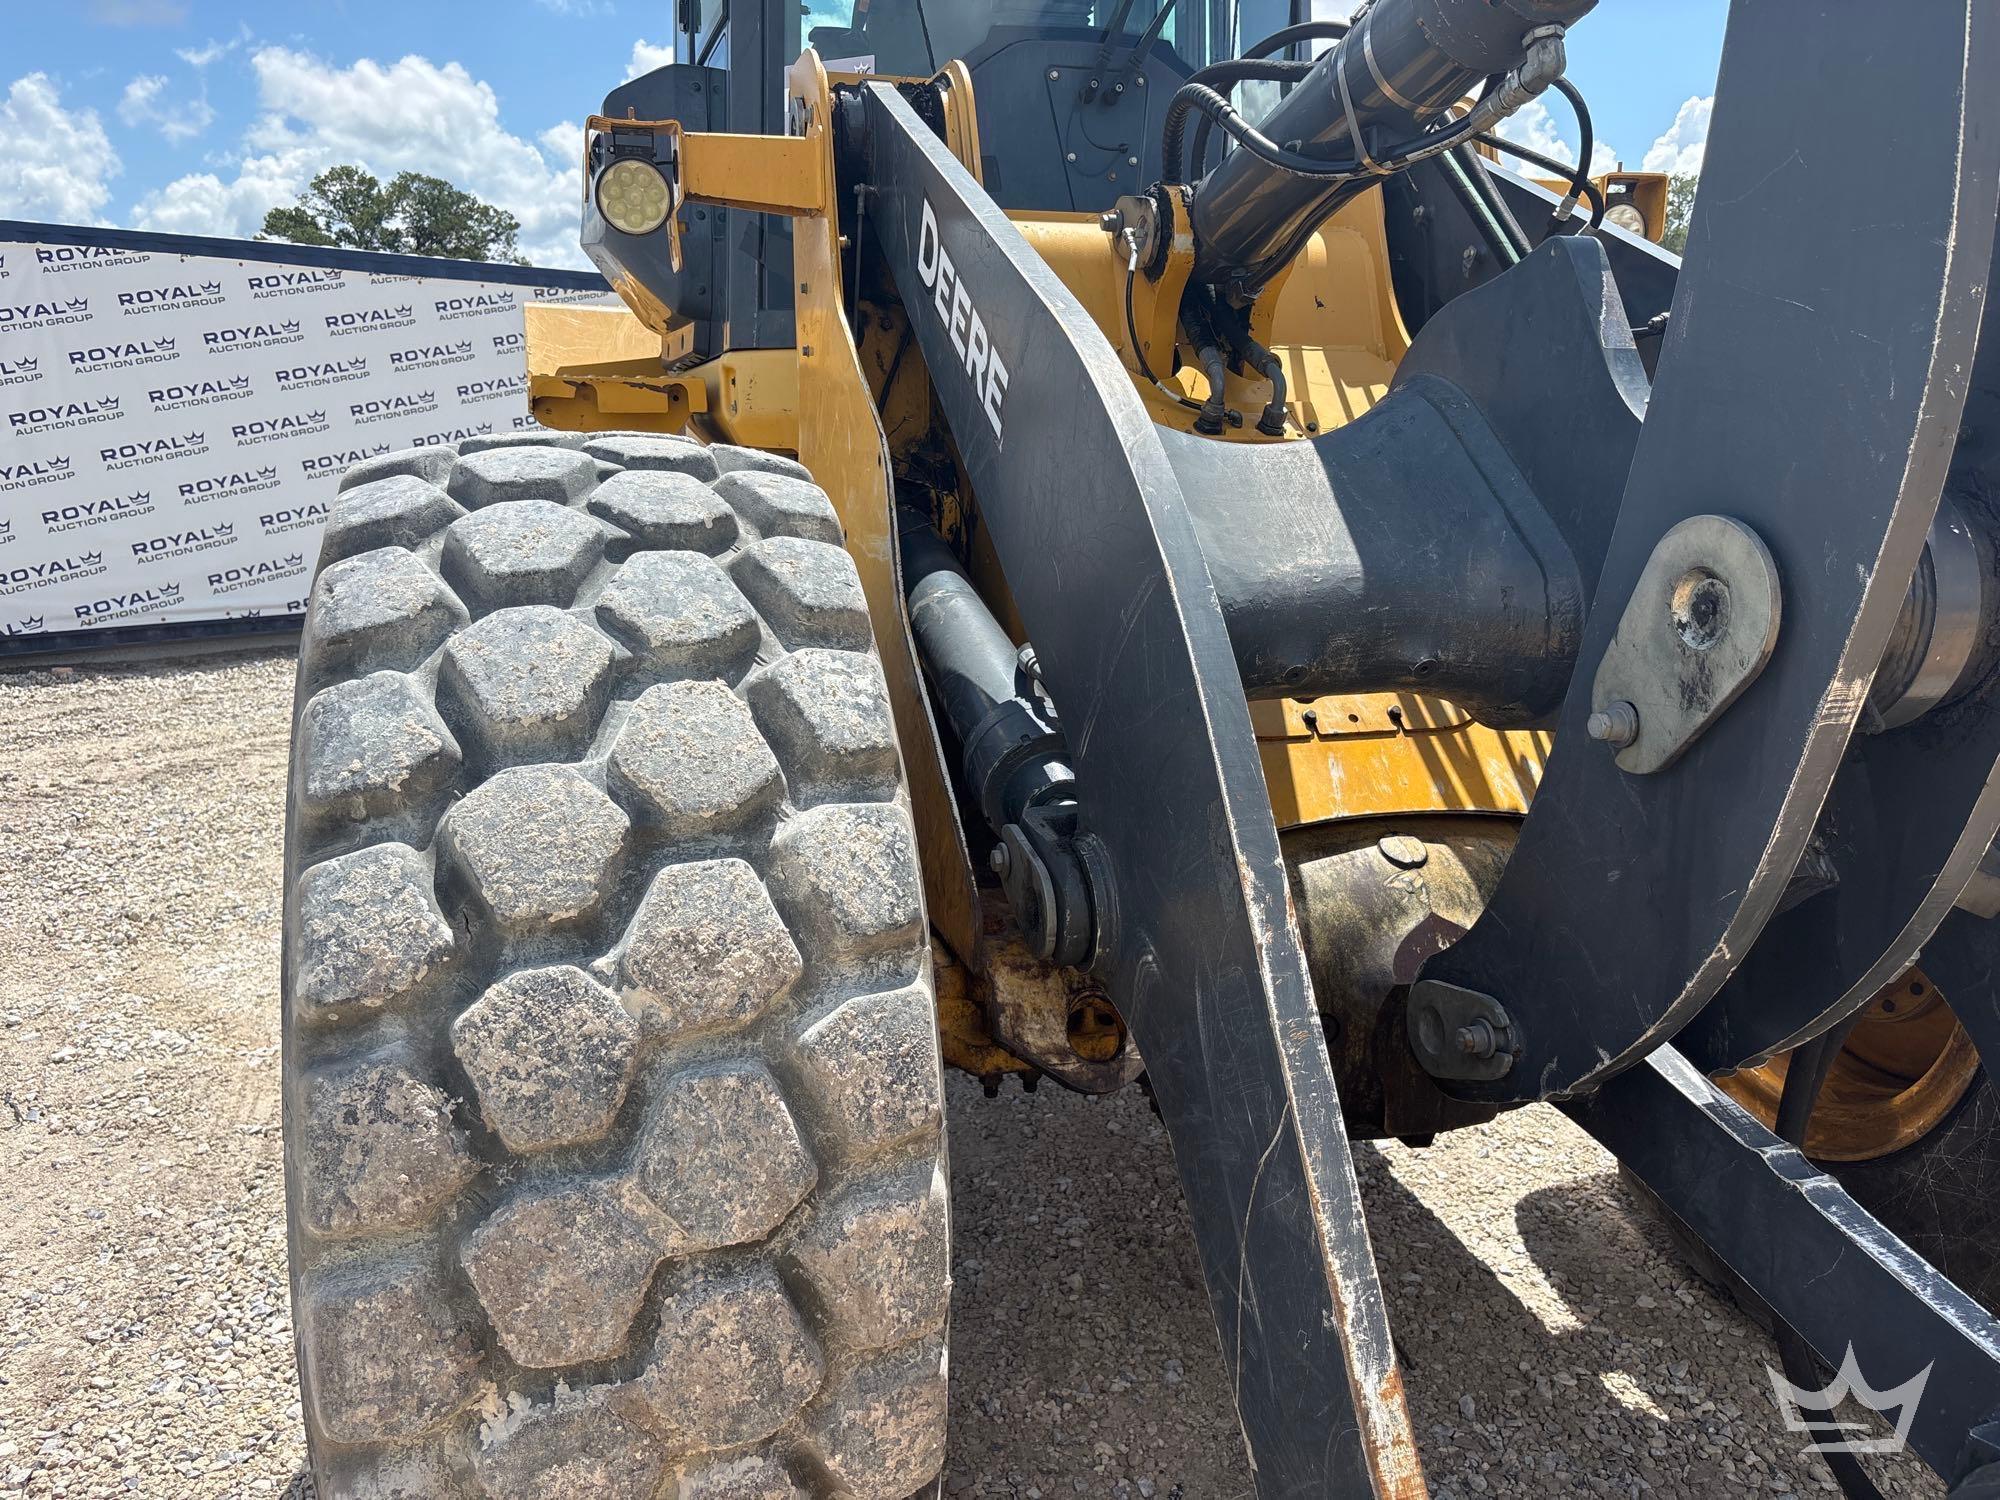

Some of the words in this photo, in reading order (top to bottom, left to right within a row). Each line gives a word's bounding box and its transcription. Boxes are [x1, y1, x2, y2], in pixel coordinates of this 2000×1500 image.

[42, 261, 102, 274] AUCTION
[105, 255, 150, 267] GROUP
[248, 271, 324, 290] ROYAL
[253, 286, 305, 299] AUCTION
[307, 282, 346, 293] GROUP
[117, 285, 201, 306] ROYAL
[123, 302, 181, 316] AUCTION
[182, 296, 226, 309] GROUP
[435, 294, 499, 313] ROYAL
[0, 302, 66, 322] OYAL
[325, 309, 396, 328] ROYAL
[439, 309, 483, 321] AUCTION
[484, 304, 517, 315] GROUP
[917, 197, 1009, 440] DEERE
[0, 320, 43, 332] CTION
[46, 314, 93, 326] GROUP
[330, 323, 378, 336] AUCTION
[380, 319, 416, 330] GROUP
[203, 324, 282, 345] ROYAL
[209, 340, 262, 354] AUCTION
[264, 334, 304, 346] GROUP
[68, 341, 155, 364] ROYAL
[74, 359, 134, 374] AUCTION
[135, 352, 180, 364] GROUP
[390, 344, 456, 364] ROYAL
[275, 361, 350, 382] ROYAL
[394, 360, 440, 373] AUCTION
[441, 354, 475, 365] GROUP
[148, 380, 230, 403] ROYAL
[280, 378, 331, 391] AUCTION
[332, 371, 370, 384] GROUP
[457, 377, 518, 397] ROYAL
[154, 397, 210, 413] AUCTION
[212, 390, 254, 403] GROUP
[350, 395, 419, 416] ROYAL
[461, 392, 503, 405] AUCTION
[8, 401, 99, 427] ROYAL
[15, 419, 75, 437] AUCTION
[78, 411, 125, 426] GROUP
[355, 411, 401, 425] AUCTION
[403, 404, 438, 416] GROUP
[232, 415, 308, 438] ROYAL
[237, 432, 289, 447] AUCTION
[290, 424, 330, 437] GROUP
[413, 428, 477, 447] ROYAL
[100, 437, 186, 462] ROYAL
[106, 454, 164, 472] AUCTION
[165, 446, 210, 460] GROUP
[0, 462, 49, 480] YAL
[302, 449, 373, 472] ROYAL
[28, 471, 75, 486] GROUP
[307, 465, 351, 481] AUCTIO
[178, 472, 258, 496] ROYAL
[184, 489, 238, 506] AUCTION
[240, 480, 281, 494] GROUP
[42, 498, 130, 524] ROYAL
[47, 516, 108, 534] AUCTION
[110, 506, 155, 521] GROUP
[260, 503, 330, 527] ROYAL
[265, 519, 315, 536] AUCTION
[131, 529, 214, 555] ROYAL
[137, 546, 193, 565] AUCTION
[195, 536, 238, 551] GROUP
[60, 565, 107, 582] GROUP
[207, 560, 285, 586] ROYAL
[213, 577, 266, 595] AUCTION
[268, 566, 307, 582] GROUP
[74, 589, 160, 618] ROYAL
[80, 607, 139, 627] AUCTION
[141, 596, 185, 613] GROUP
